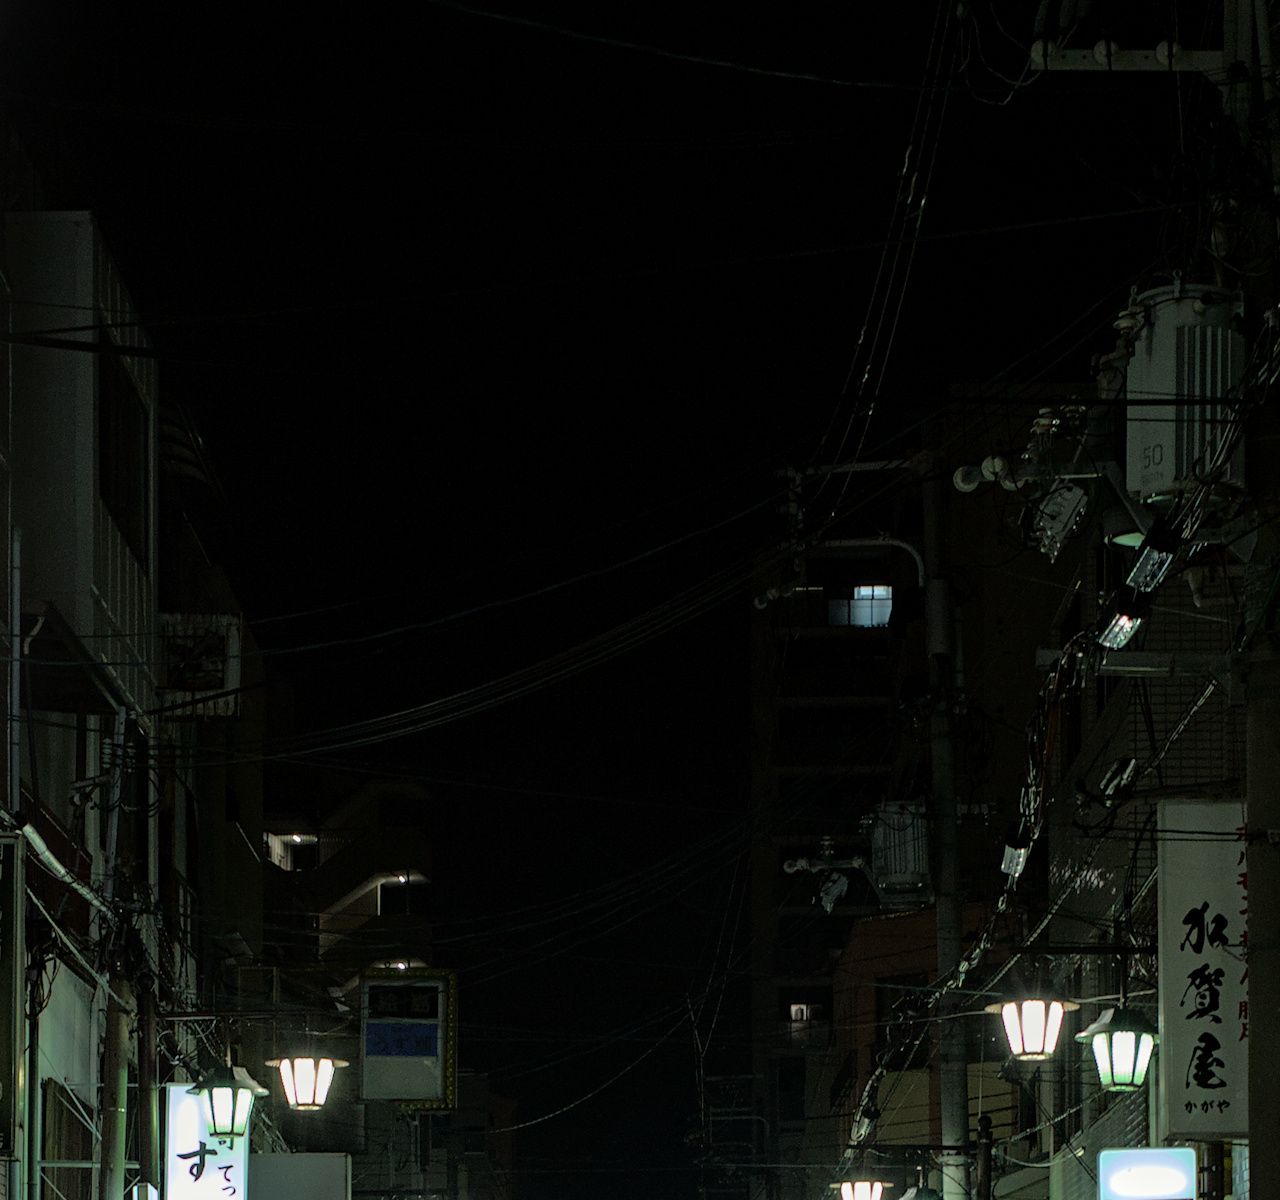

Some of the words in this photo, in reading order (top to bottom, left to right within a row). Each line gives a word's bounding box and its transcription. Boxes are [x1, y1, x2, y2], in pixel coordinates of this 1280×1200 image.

[1179, 901, 1229, 1090] 加賀屋
[1184, 1099, 1230, 1115] かがや
